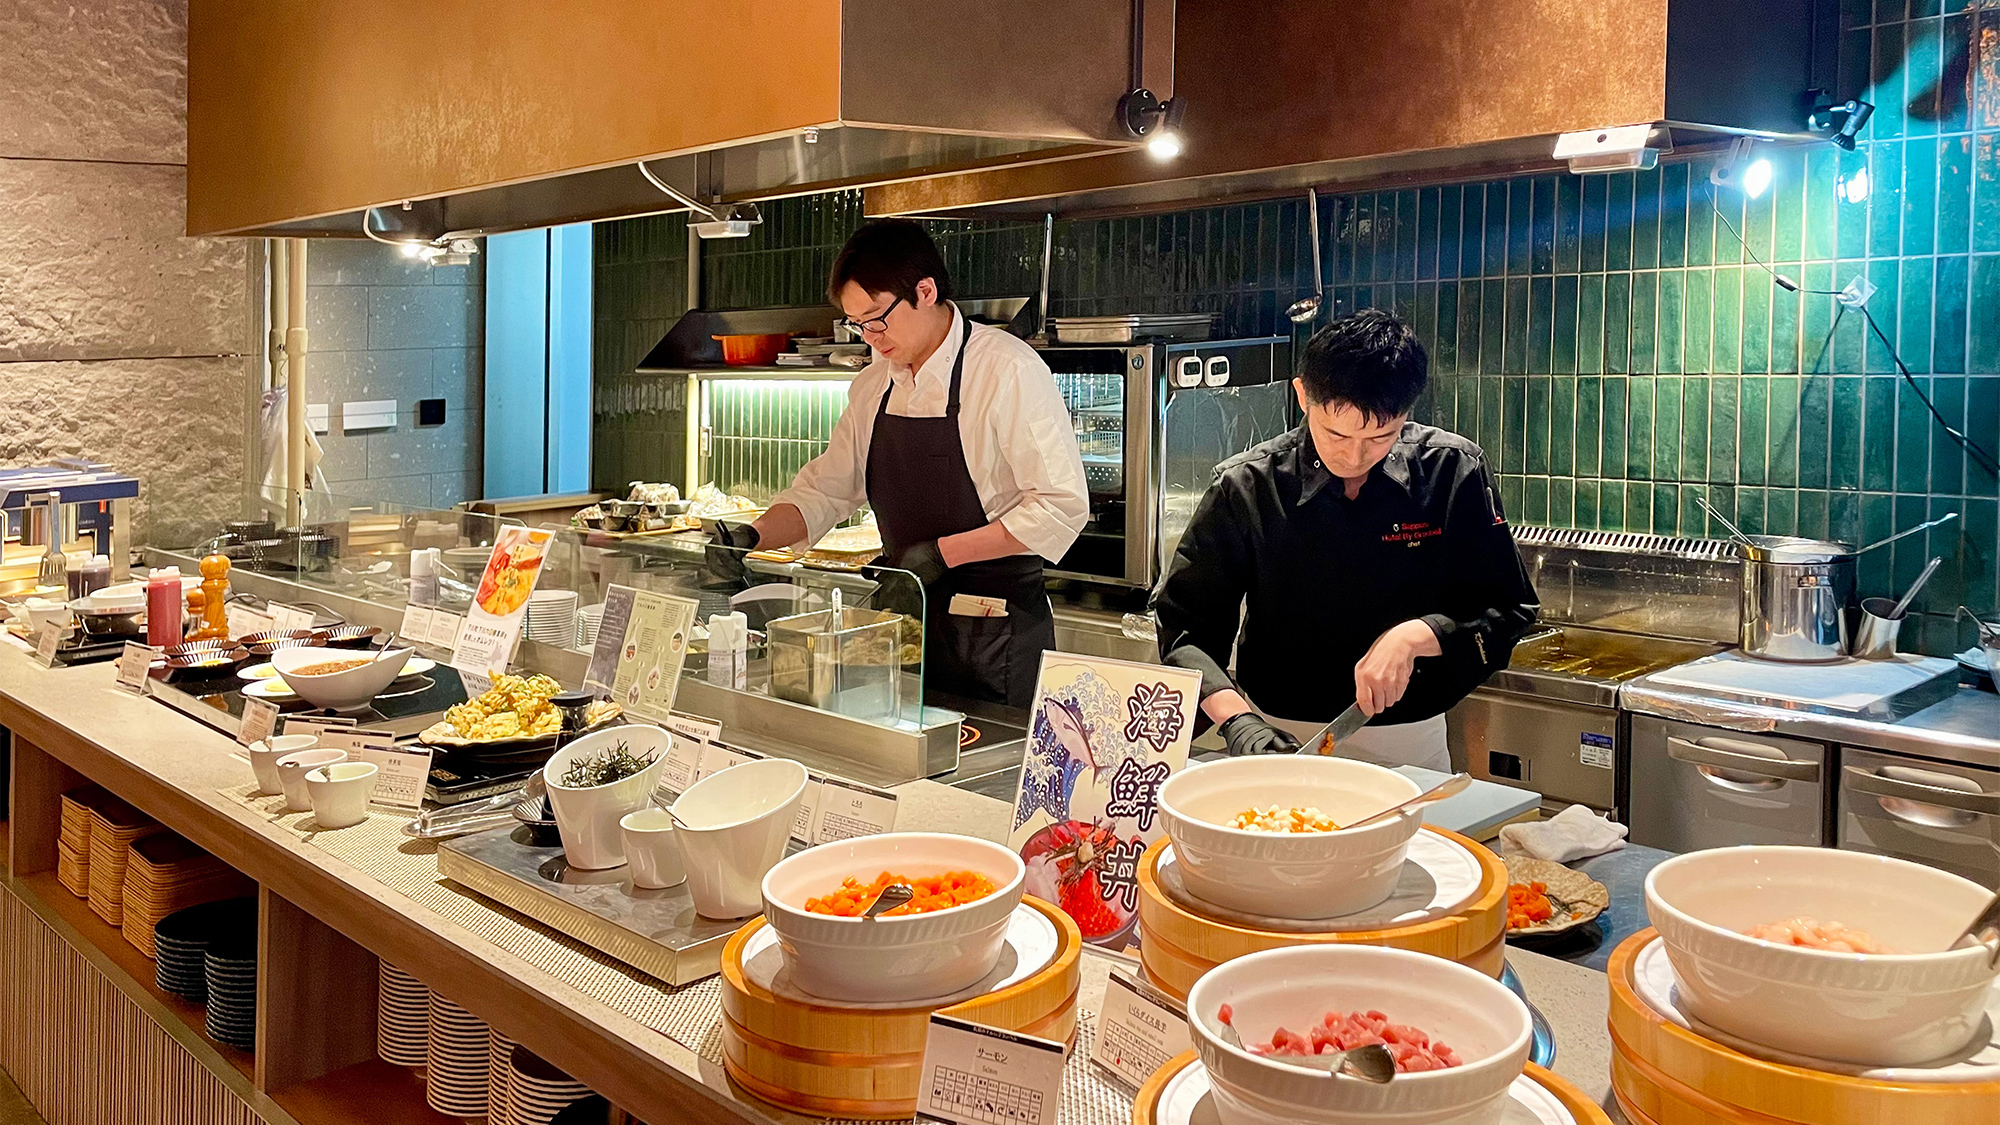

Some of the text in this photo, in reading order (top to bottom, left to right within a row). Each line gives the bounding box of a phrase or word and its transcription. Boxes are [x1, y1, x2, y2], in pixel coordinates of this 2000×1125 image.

[1101, 682, 1183, 911] 海鮮丼
[976, 1047, 1008, 1062] サーモン
